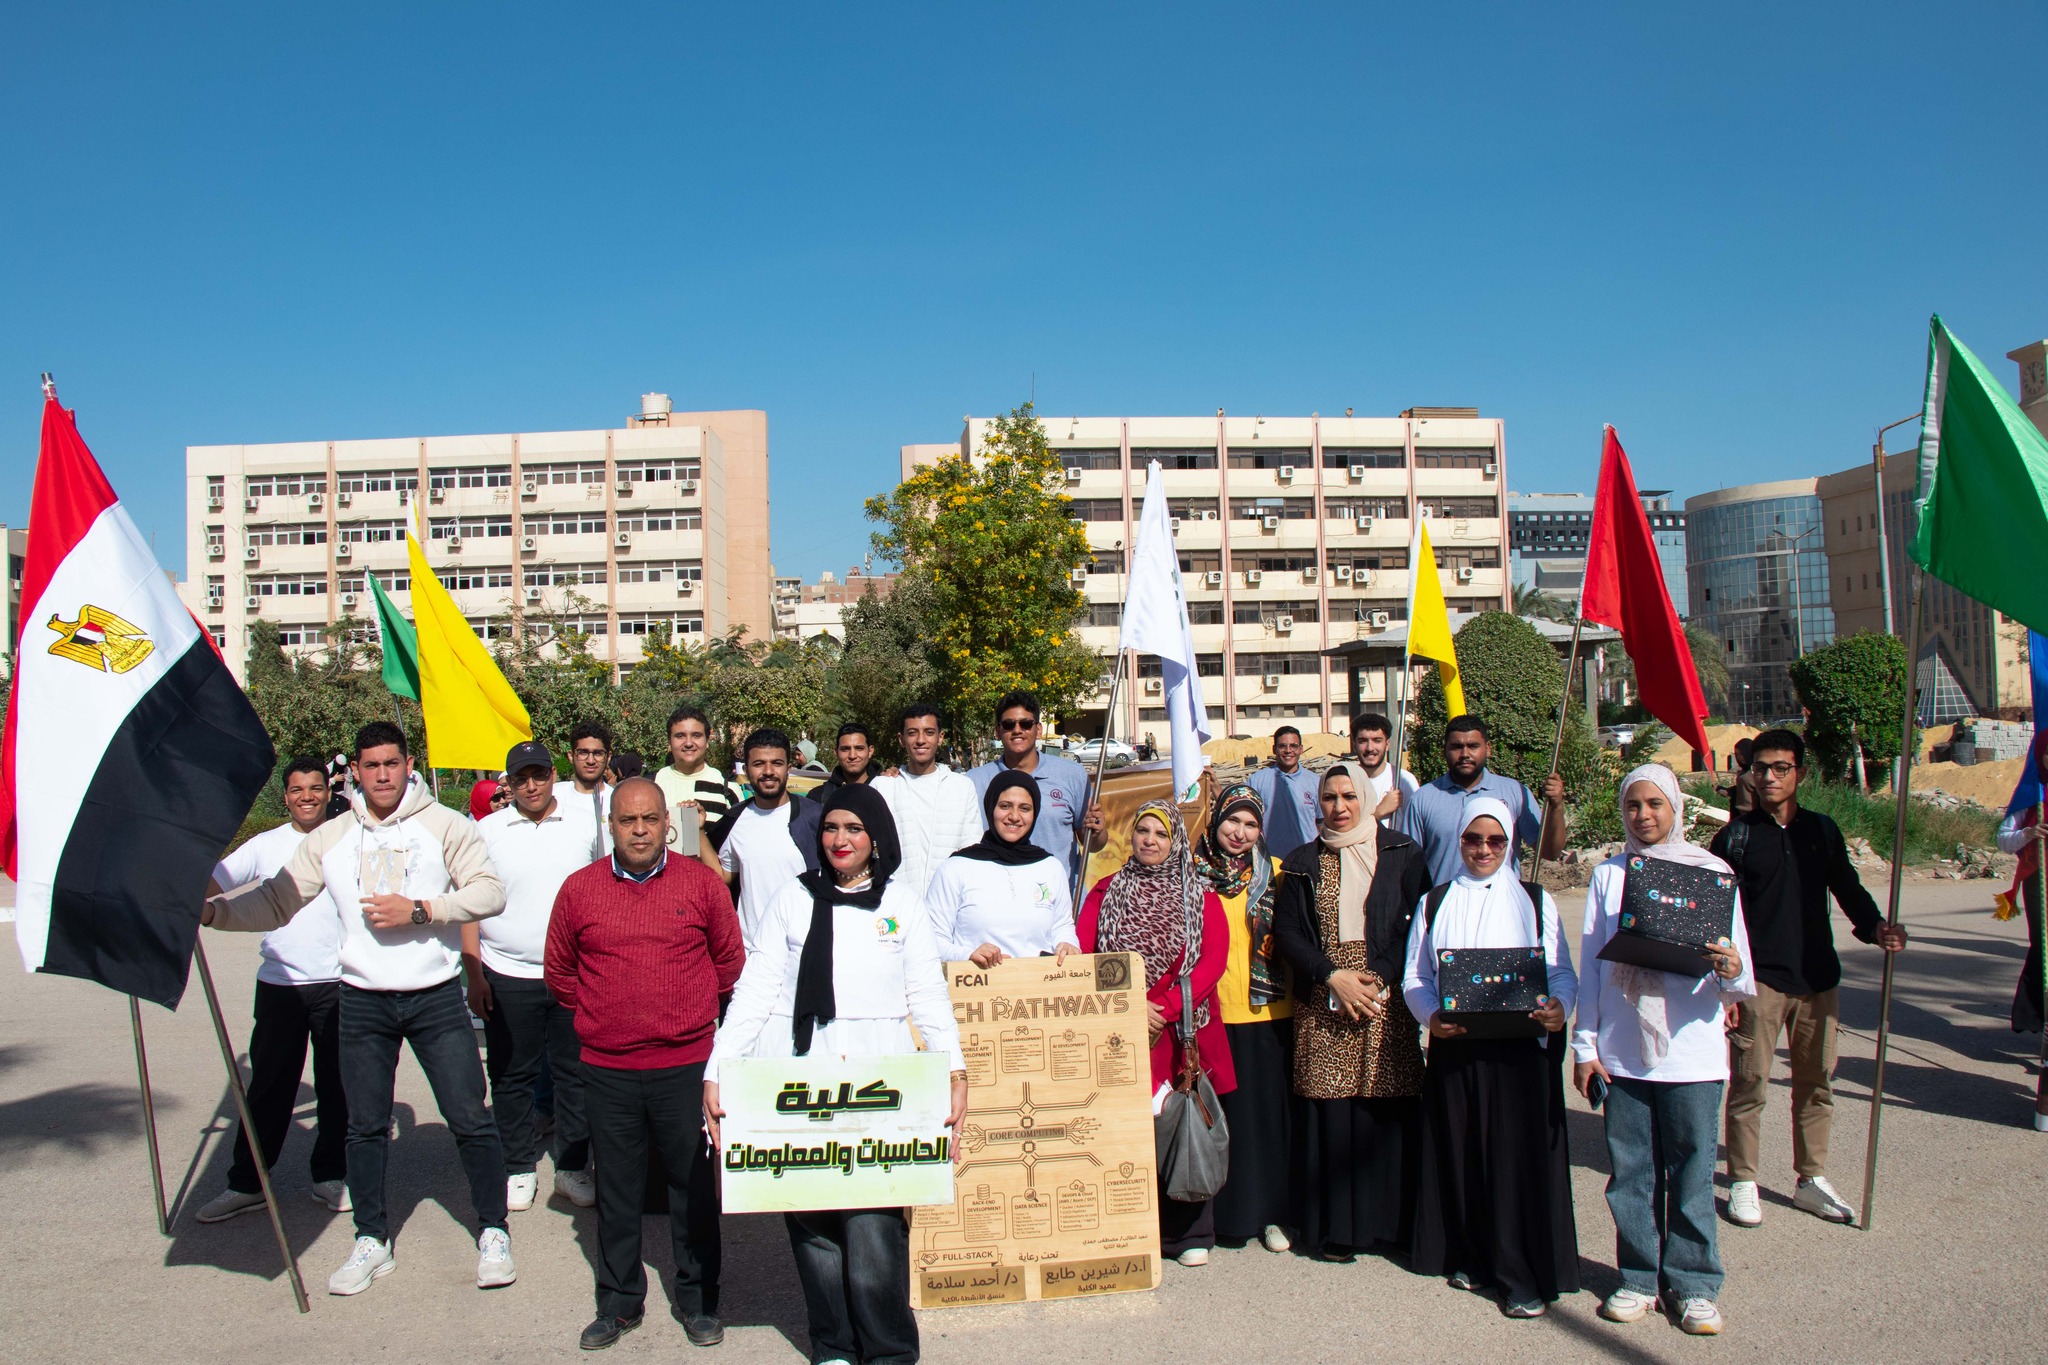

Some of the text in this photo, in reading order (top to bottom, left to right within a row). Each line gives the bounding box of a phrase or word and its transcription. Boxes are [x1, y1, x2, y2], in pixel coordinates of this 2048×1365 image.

[1648, 888, 1697, 910] Google
[955, 974, 989, 988] FCAI
[1043, 970, 1092, 981] جامعة الفيوم
[1471, 973, 1526, 984] Google
[953, 992, 1130, 1024] CH PATHWAYS
[775, 1079, 902, 1120] كلية
[989, 1127, 1065, 1140] CORE COMPUTING
[725, 1137, 949, 1177] الحاسبات والمعلومات
[1106, 1178, 1146, 1186] CYBERSECURITY
[942, 1250, 994, 1261] FULL-STACK
[1018, 1250, 1059, 1263] تحت رعاية
[1045, 1266, 1076, 1284] طايع
[1081, 1263, 1120, 1281] شيرين
[927, 1268, 1018, 1290] د/ أحمد سلامة
[1077, 1282, 1117, 1292] عميد الكلية
[940, 1292, 1006, 1304] منسق الأنشطة بالكلية
